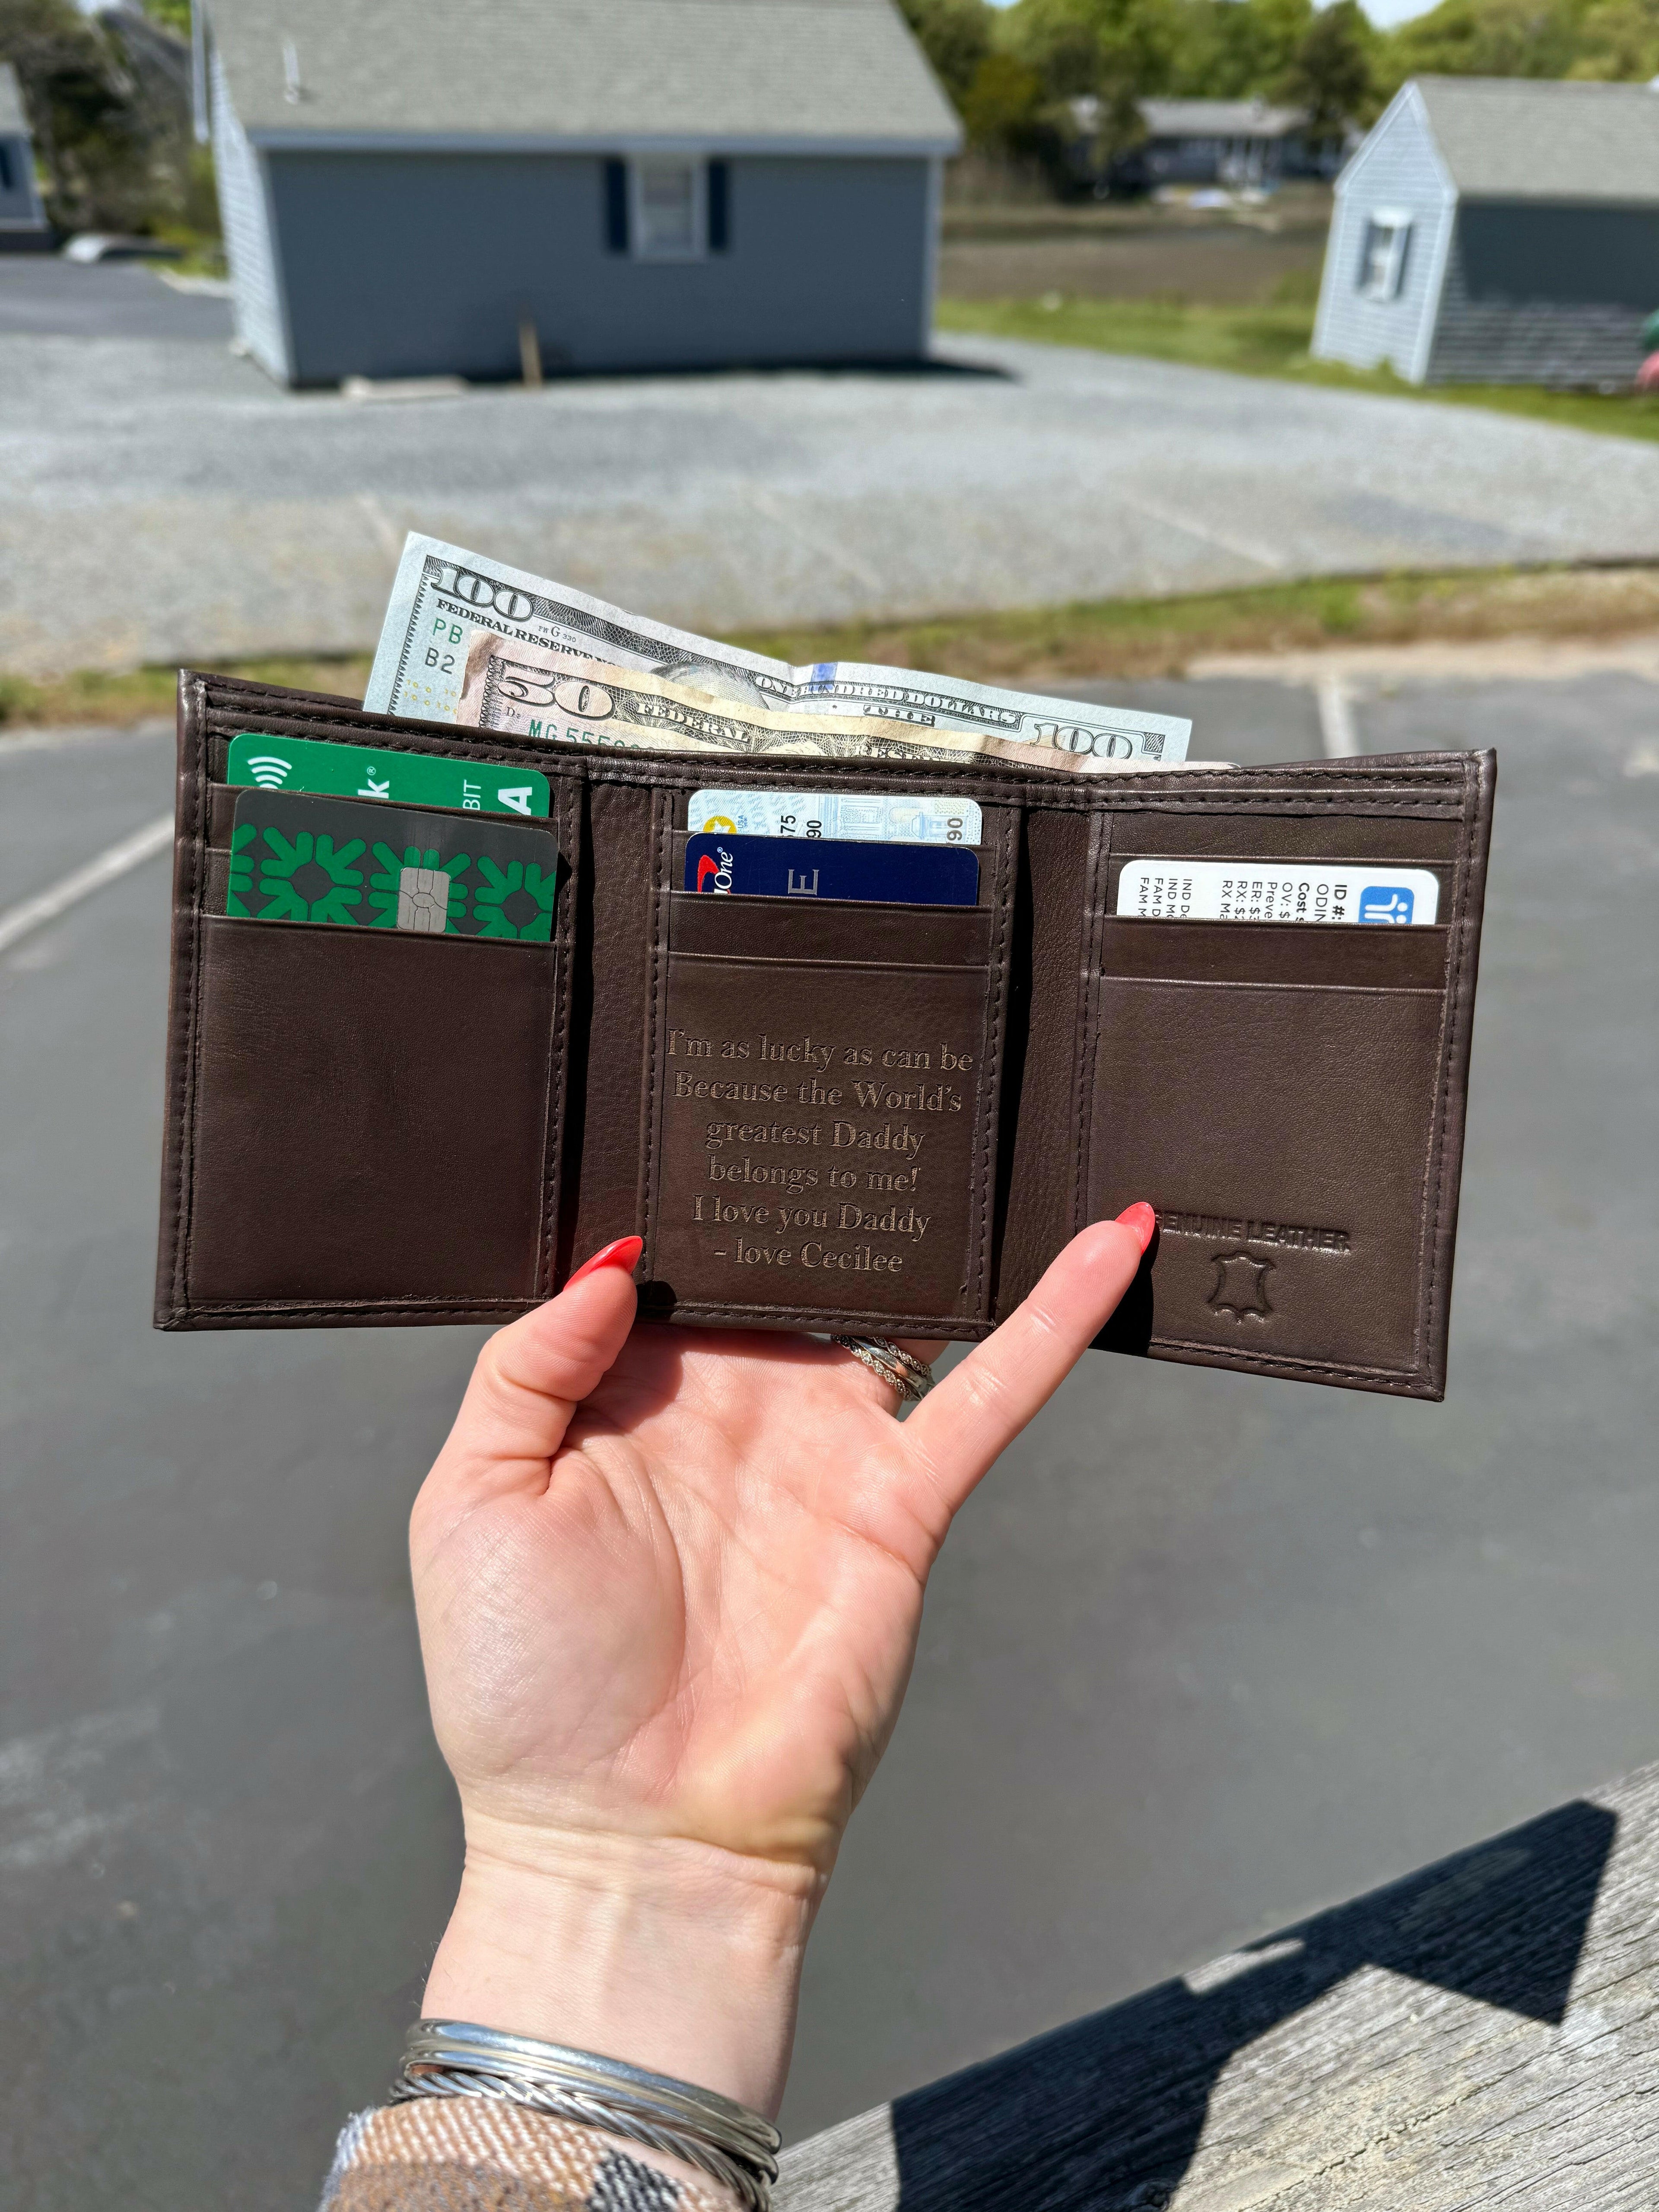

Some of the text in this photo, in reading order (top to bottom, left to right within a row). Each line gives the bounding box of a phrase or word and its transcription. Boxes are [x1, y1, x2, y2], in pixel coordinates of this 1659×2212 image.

[431, 566, 534, 622] 100
[432, 617, 463, 644] PB
[436, 598, 513, 636] FEDERAL
[425, 647, 455, 674] B2
[498, 661, 616, 721] 50
[756, 677, 1017, 725] ONE HUNDRED DOLLARS
[636, 703, 750, 743] FEDERAL
[1030, 722, 1133, 760] 100
[463, 779, 481, 810] BIT
[498, 786, 532, 816] A
[780, 815, 796, 837] 75
[788, 868, 820, 896] E
[1139, 877, 1149, 903] FAM
[1153, 878, 1163, 904] FAM
[1168, 878, 1178, 899] IND
[1182, 879, 1192, 900] IND
[1221, 880, 1233, 898] RX
[1236, 880, 1248, 902] RX:
[1251, 881, 1263, 902] ER:
[1281, 882, 1293, 906] OV:
[1297, 882, 1310, 913] Cost
[1264, 882, 1278, 919] Preve
[1332, 884, 1348, 920] ID #:
[666, 1027, 973, 1072] I'm as lucky as can be
[672, 1070, 962, 1112] Because the World's
[706, 1120, 925, 1160] greatest Daddy
[709, 1154, 919, 1194] belongs to me!
[692, 1194, 931, 1242] I love you Daddy
[1247, 1221, 1351, 1254] LEATHER
[734, 1237, 791, 1266] love
[800, 1241, 903, 1273] Cecilee
